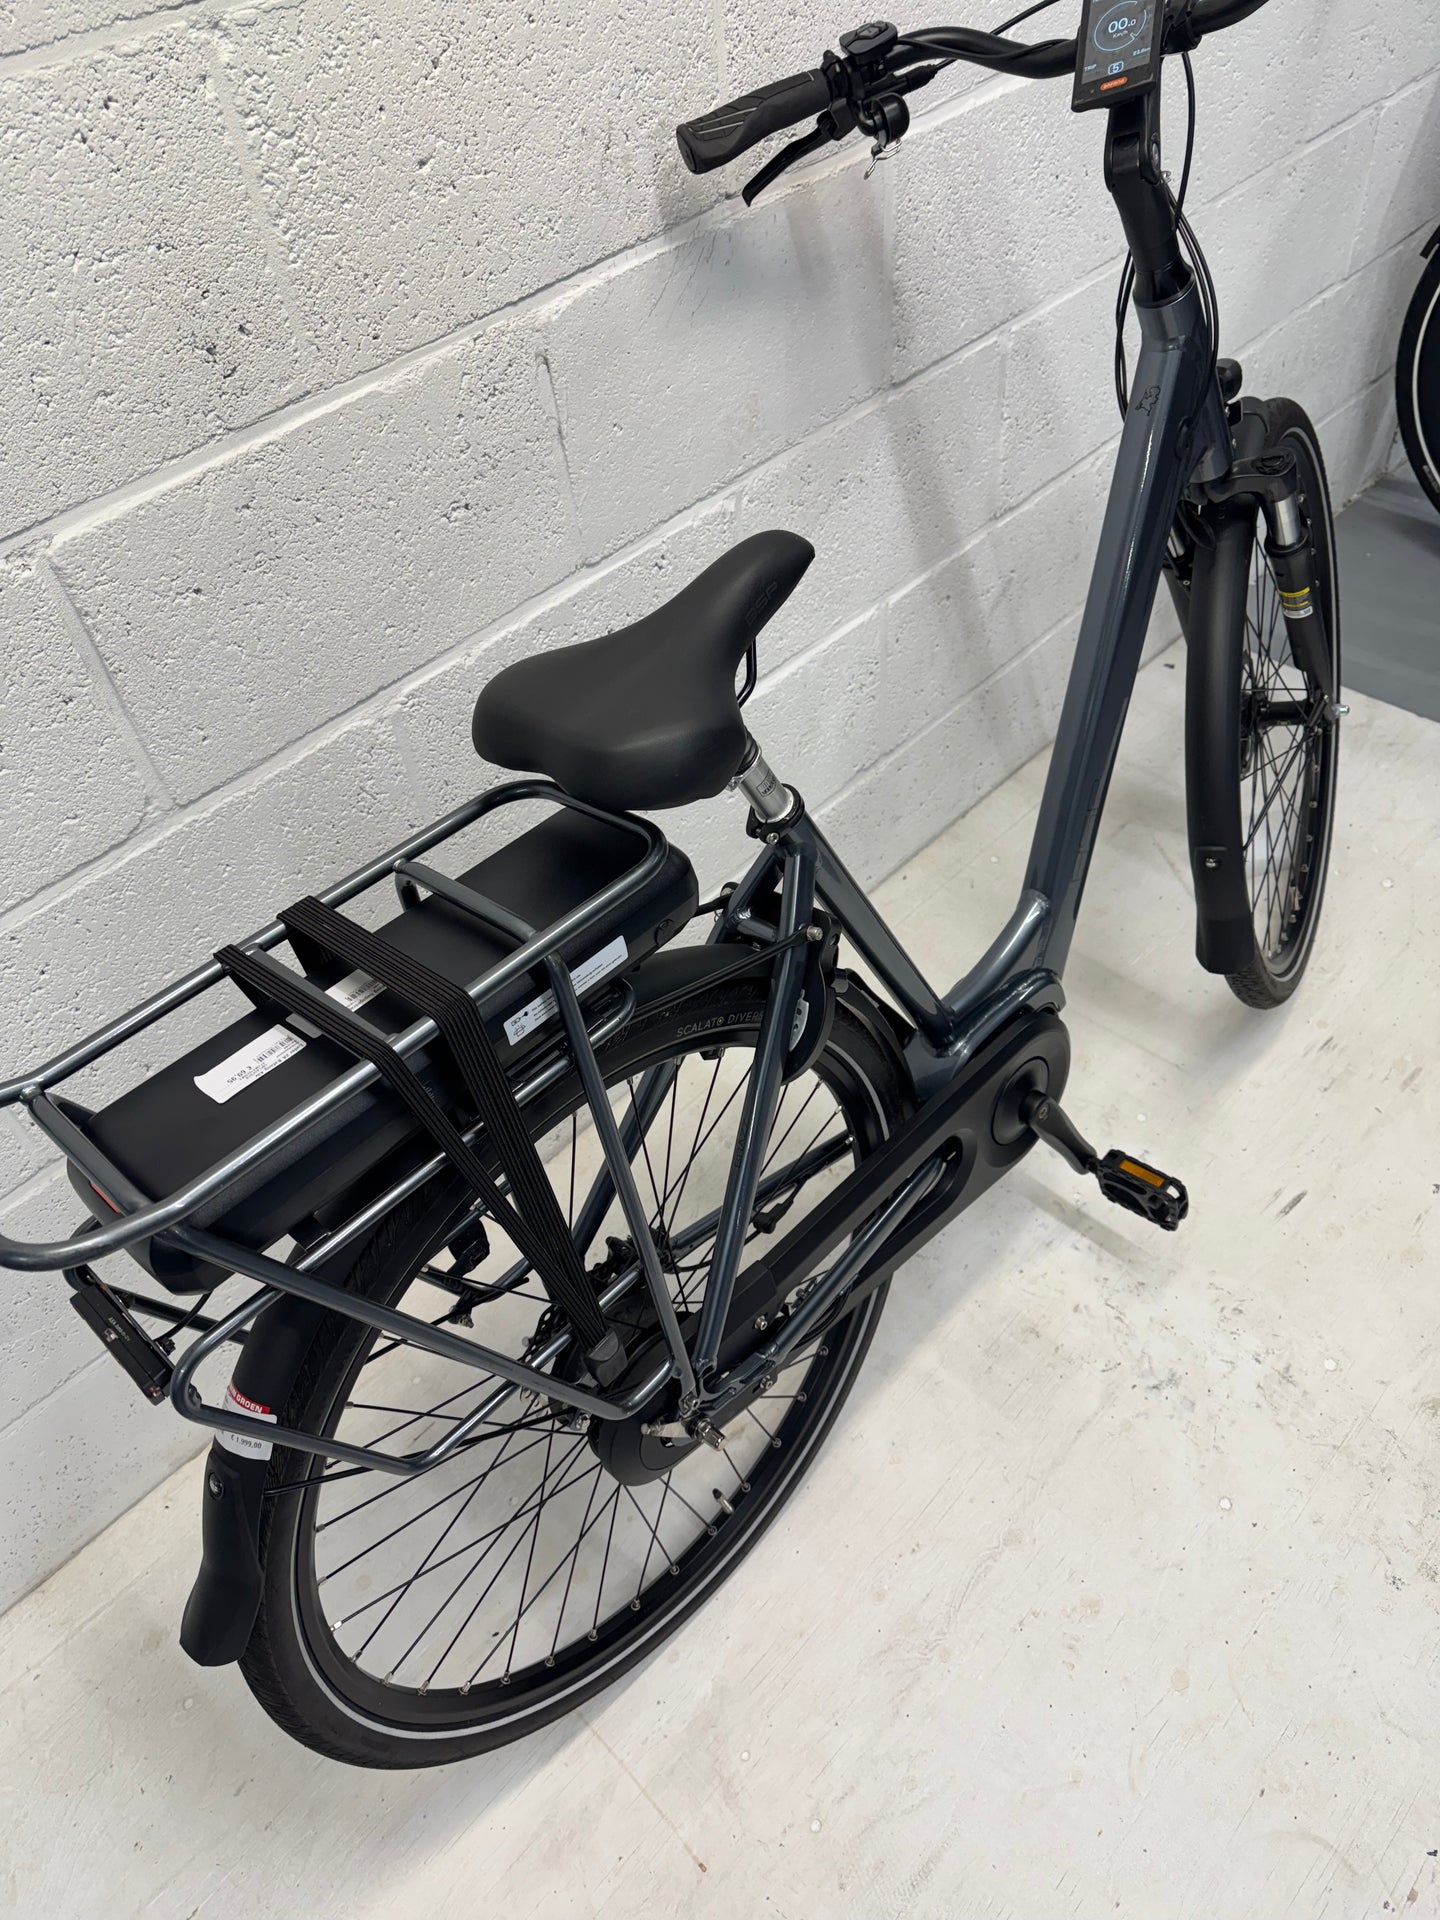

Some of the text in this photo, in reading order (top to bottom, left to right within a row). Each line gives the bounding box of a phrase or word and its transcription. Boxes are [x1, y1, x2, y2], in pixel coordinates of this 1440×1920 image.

[1108, 17, 1137, 33] 00.0
[1112, 64, 1121, 73] 5
[676, 1016, 725, 1038] SCALATO
[236, 1395, 263, 1414] GROEN
